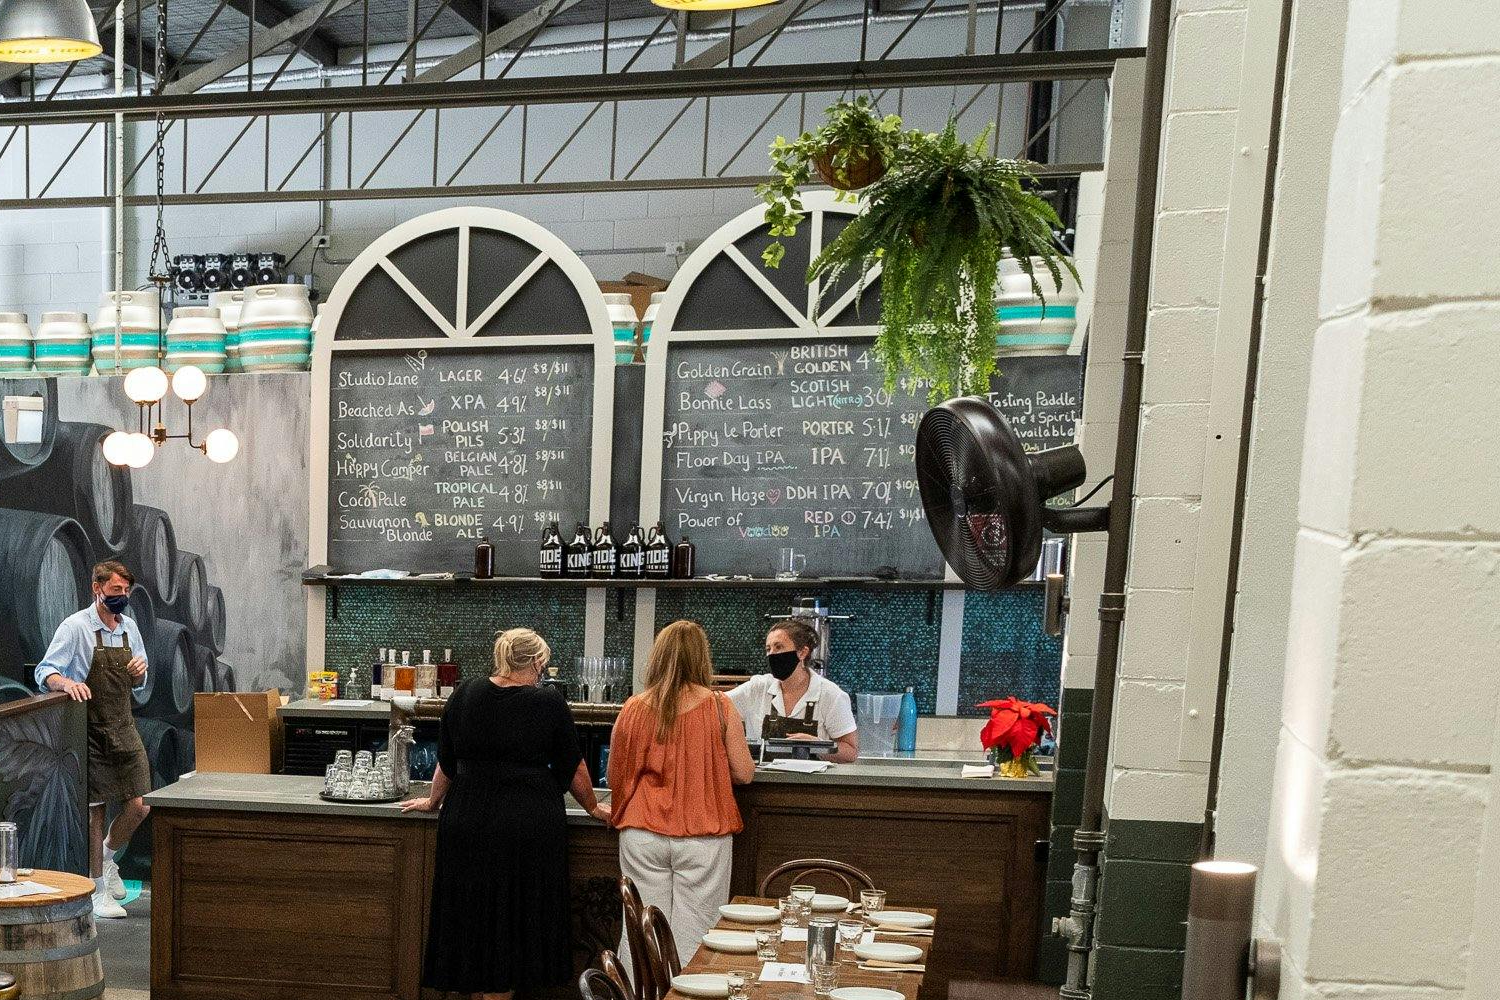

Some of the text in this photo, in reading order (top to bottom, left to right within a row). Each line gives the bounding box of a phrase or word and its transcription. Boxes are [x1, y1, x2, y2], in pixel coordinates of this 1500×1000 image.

[790, 344, 848, 360] BRITISH
[338, 371, 385, 387] Studio
[387, 371, 419, 386] Lane
[439, 369, 483, 382] LAGER
[677, 361, 729, 380] Golden
[731, 361, 772, 378] Grain
[794, 360, 851, 374] GOLDEN
[790, 379, 850, 393] SCOTISH
[338, 400, 393, 419] Beached
[396, 400, 415, 416] As
[450, 393, 486, 411] XPA
[678, 391, 734, 411] Bonnie
[738, 395, 772, 410] Lass
[791, 394, 834, 408] LIGHT
[984, 390, 1076, 415] Tasting Paddle
[442, 419, 489, 434] POLISH
[678, 421, 719, 447] Pippy
[723, 422, 739, 438] le
[742, 421, 784, 438] Porter
[802, 419, 854, 436] PORTER
[337, 431, 412, 454] Solidarity
[456, 434, 485, 448] PILS
[444, 450, 497, 464] BELGIAN
[676, 452, 719, 469] Floor
[723, 451, 750, 472] Day
[756, 450, 786, 465] IPA
[811, 447, 846, 465] IPA
[336, 459, 379, 479] Hippy
[381, 459, 430, 481] Camper
[460, 464, 494, 477] PALE
[434, 481, 498, 494] TROPICAL
[675, 487, 724, 509] Virgin
[786, 485, 817, 500] DDH
[822, 484, 851, 500] IPA
[338, 491, 372, 508] Coco
[378, 491, 407, 507] Pale
[453, 495, 486, 509] PALE
[339, 514, 412, 535] Sauvignon
[434, 513, 483, 527] BLONDE
[678, 512, 721, 529] Power
[726, 511, 743, 526] of
[804, 510, 834, 524] RED
[386, 527, 484, 542] Blonde ALE
[813, 524, 841, 538] IPA
[540, 549, 561, 563] TIDE
[567, 552, 592, 568] KING
[593, 549, 616, 564] TIDE
[620, 552, 645, 568] KING
[646, 549, 669, 564] TIDE
